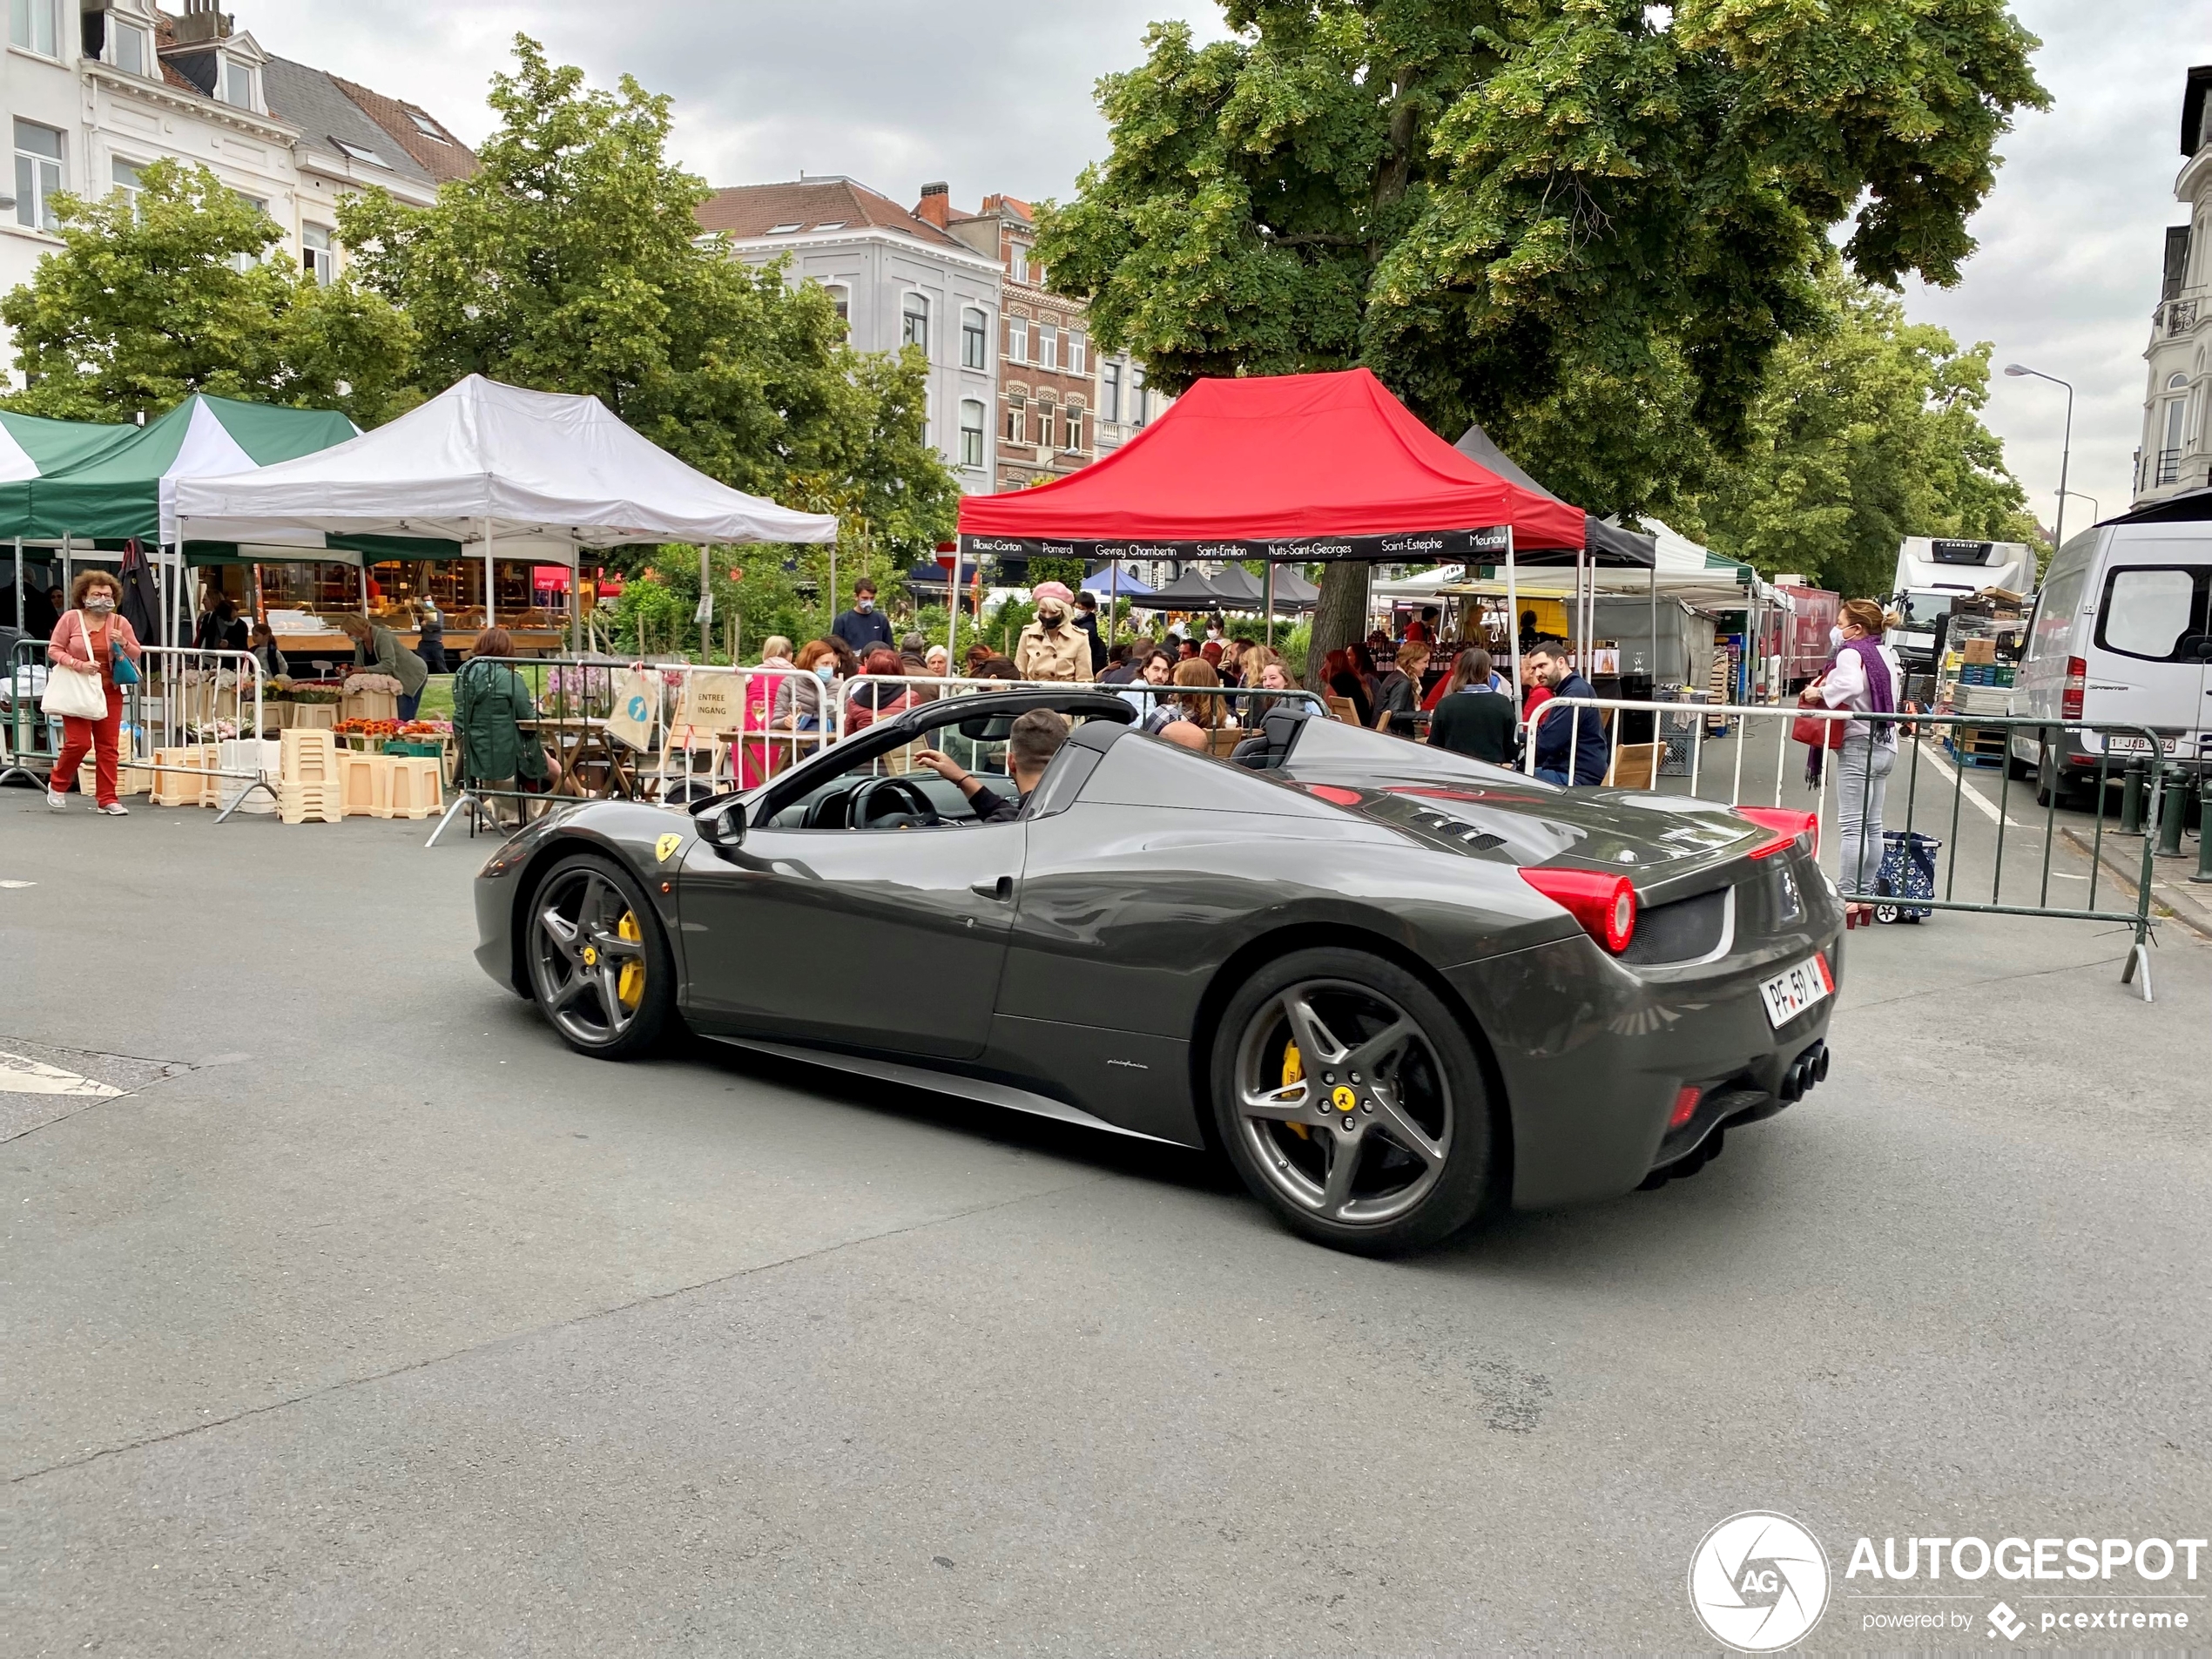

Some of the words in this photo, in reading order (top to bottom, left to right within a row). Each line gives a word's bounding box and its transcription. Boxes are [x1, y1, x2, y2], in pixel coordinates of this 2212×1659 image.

[973, 538, 1022, 552] Aloxe-Corton
[1042, 543, 1074, 555] Pomerol
[1095, 544, 1126, 559] Gevrey
[1129, 544, 1177, 556] Chambertin
[1197, 544, 1247, 556] Saint-Emilion
[1268, 543, 1352, 557] Nuits-Saint-Georges
[1381, 538, 1443, 553] Saint-Estephe
[1769, 980, 1788, 1017] PF
[1791, 969, 1808, 1004] 59
